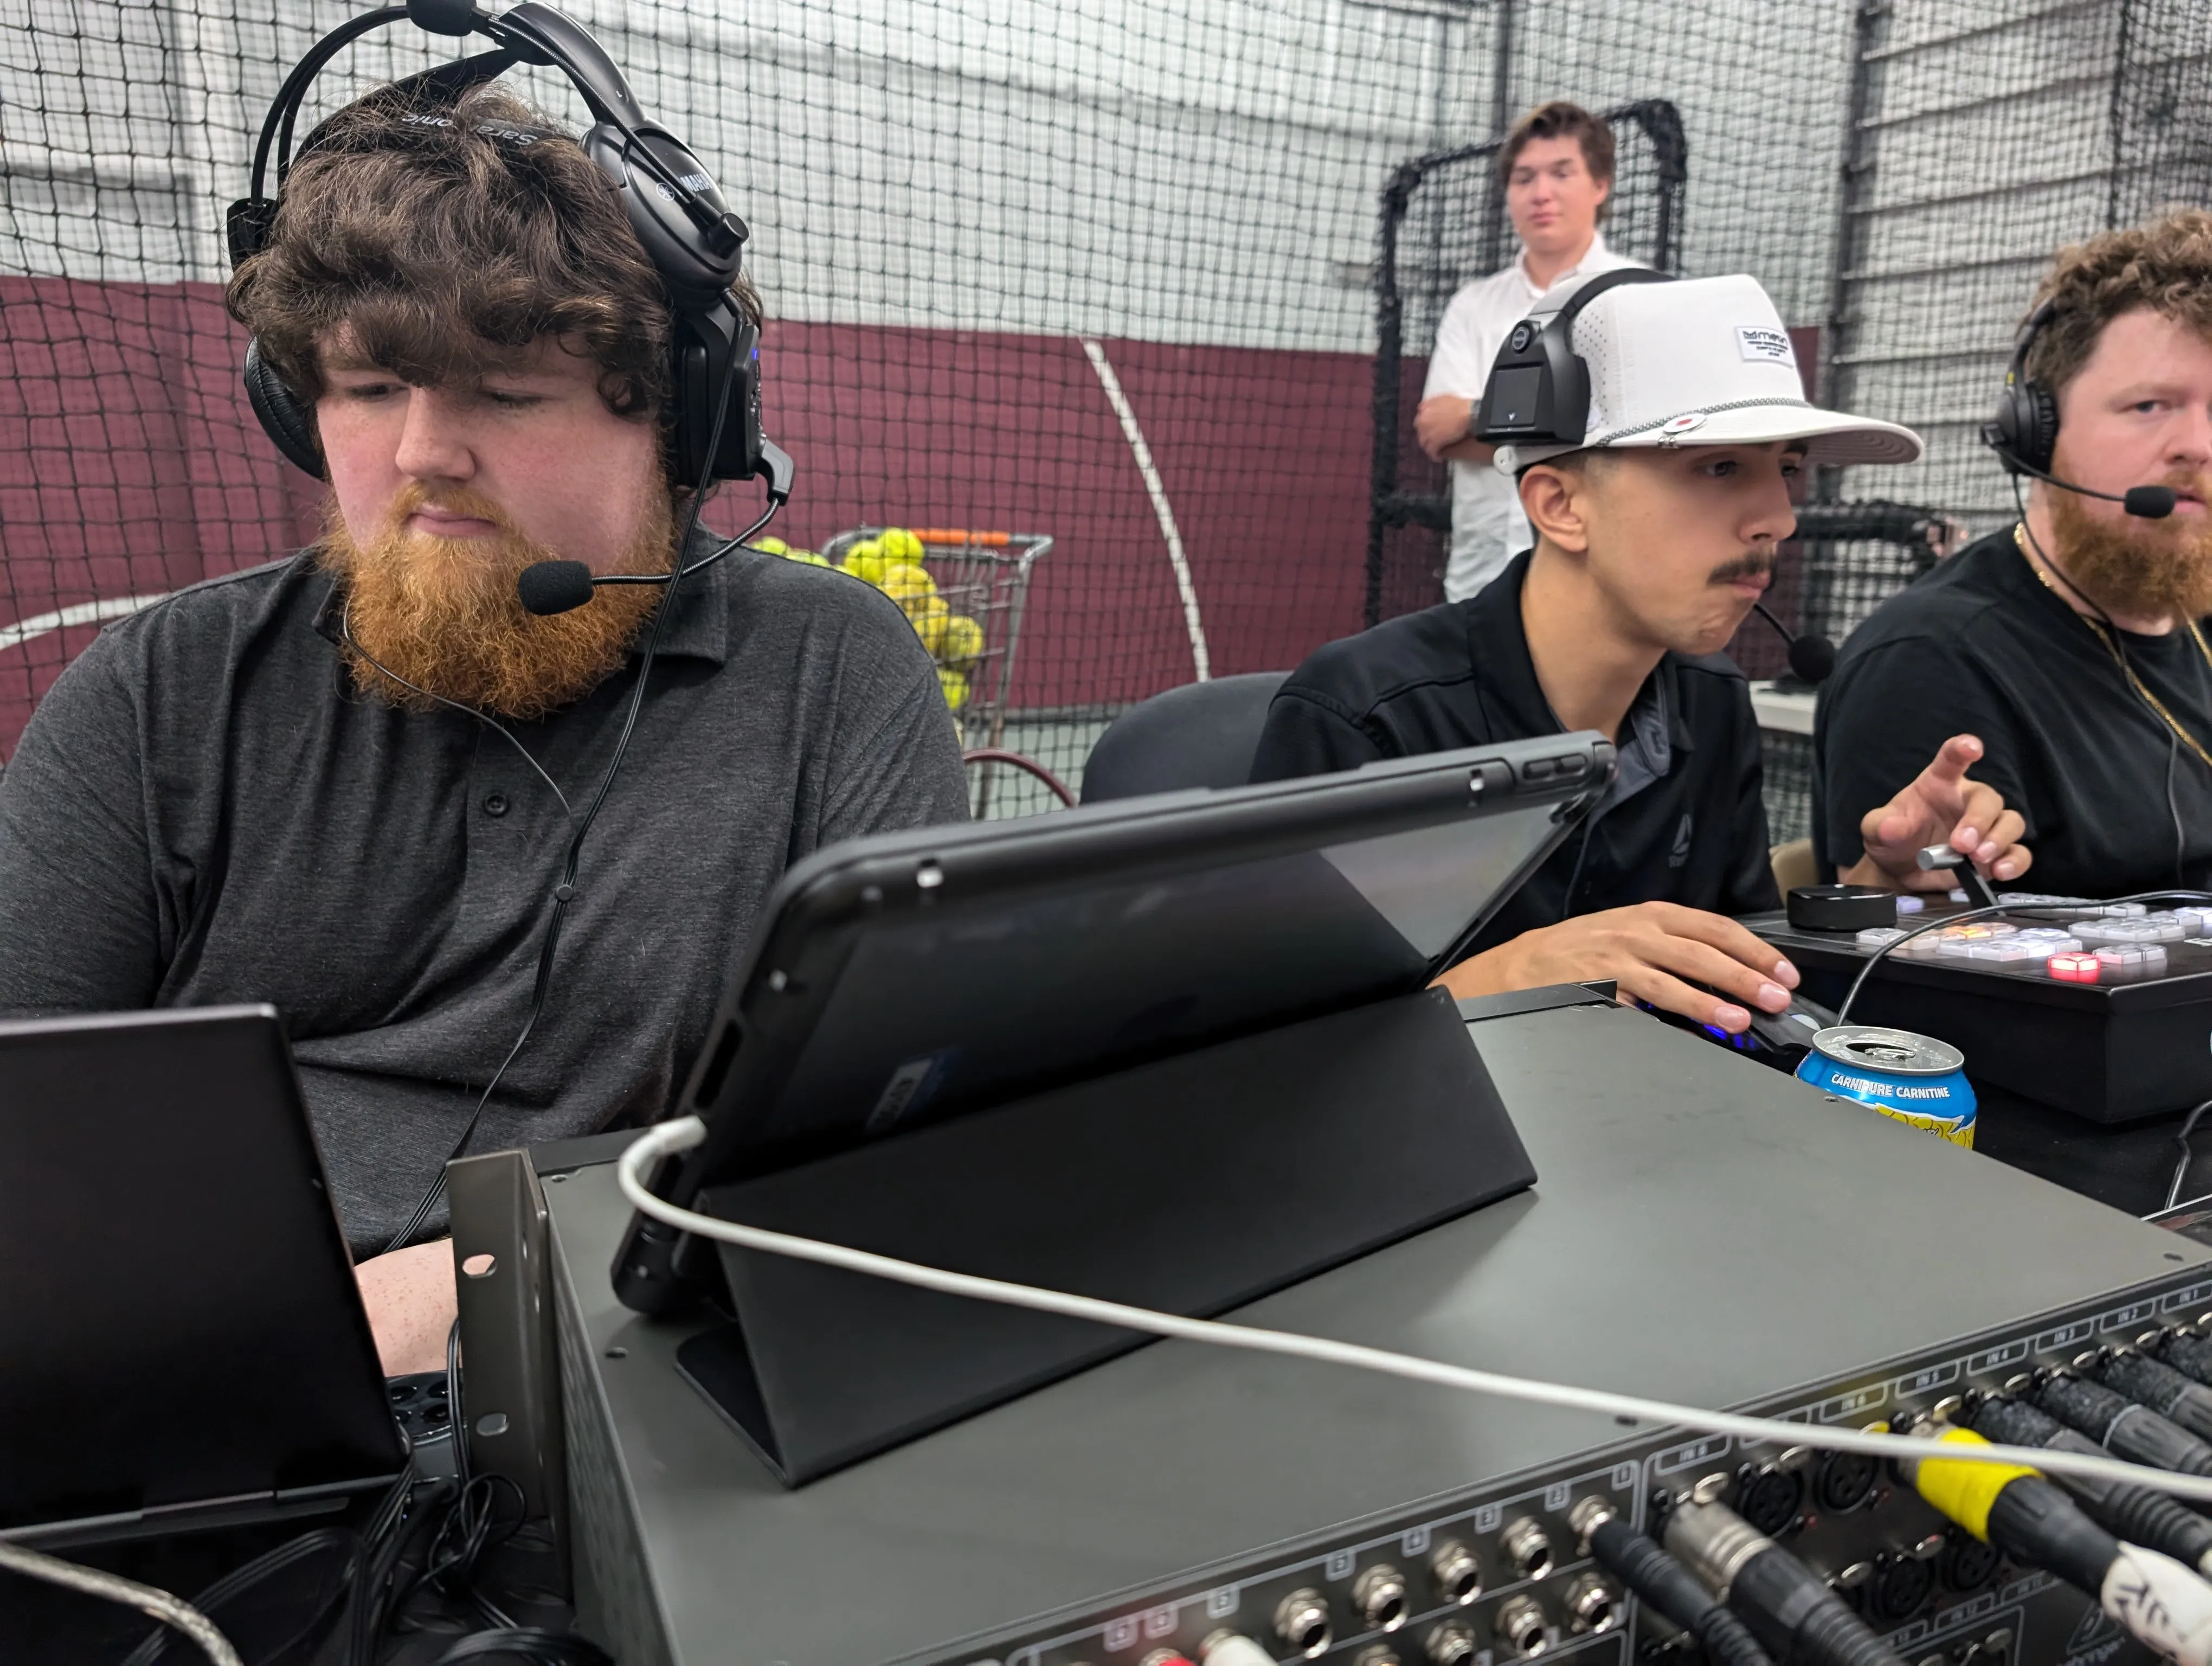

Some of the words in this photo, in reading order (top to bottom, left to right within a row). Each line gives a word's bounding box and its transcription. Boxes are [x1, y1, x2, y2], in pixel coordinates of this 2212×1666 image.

[401, 114, 538, 146] Saraonic
[1830, 1073, 1894, 1097] CARNIPURE
[1896, 1086, 1951, 1099] CARNITINE
[2117, 1309, 2130, 1323] IN
[2131, 1307, 2139, 1320] 2
[2053, 1330, 2067, 1344] IN
[2068, 1328, 2076, 1340] 3
[1986, 1350, 2000, 1367] IN
[2001, 1348, 2009, 1360] 4
[1915, 1373, 1931, 1388] IN
